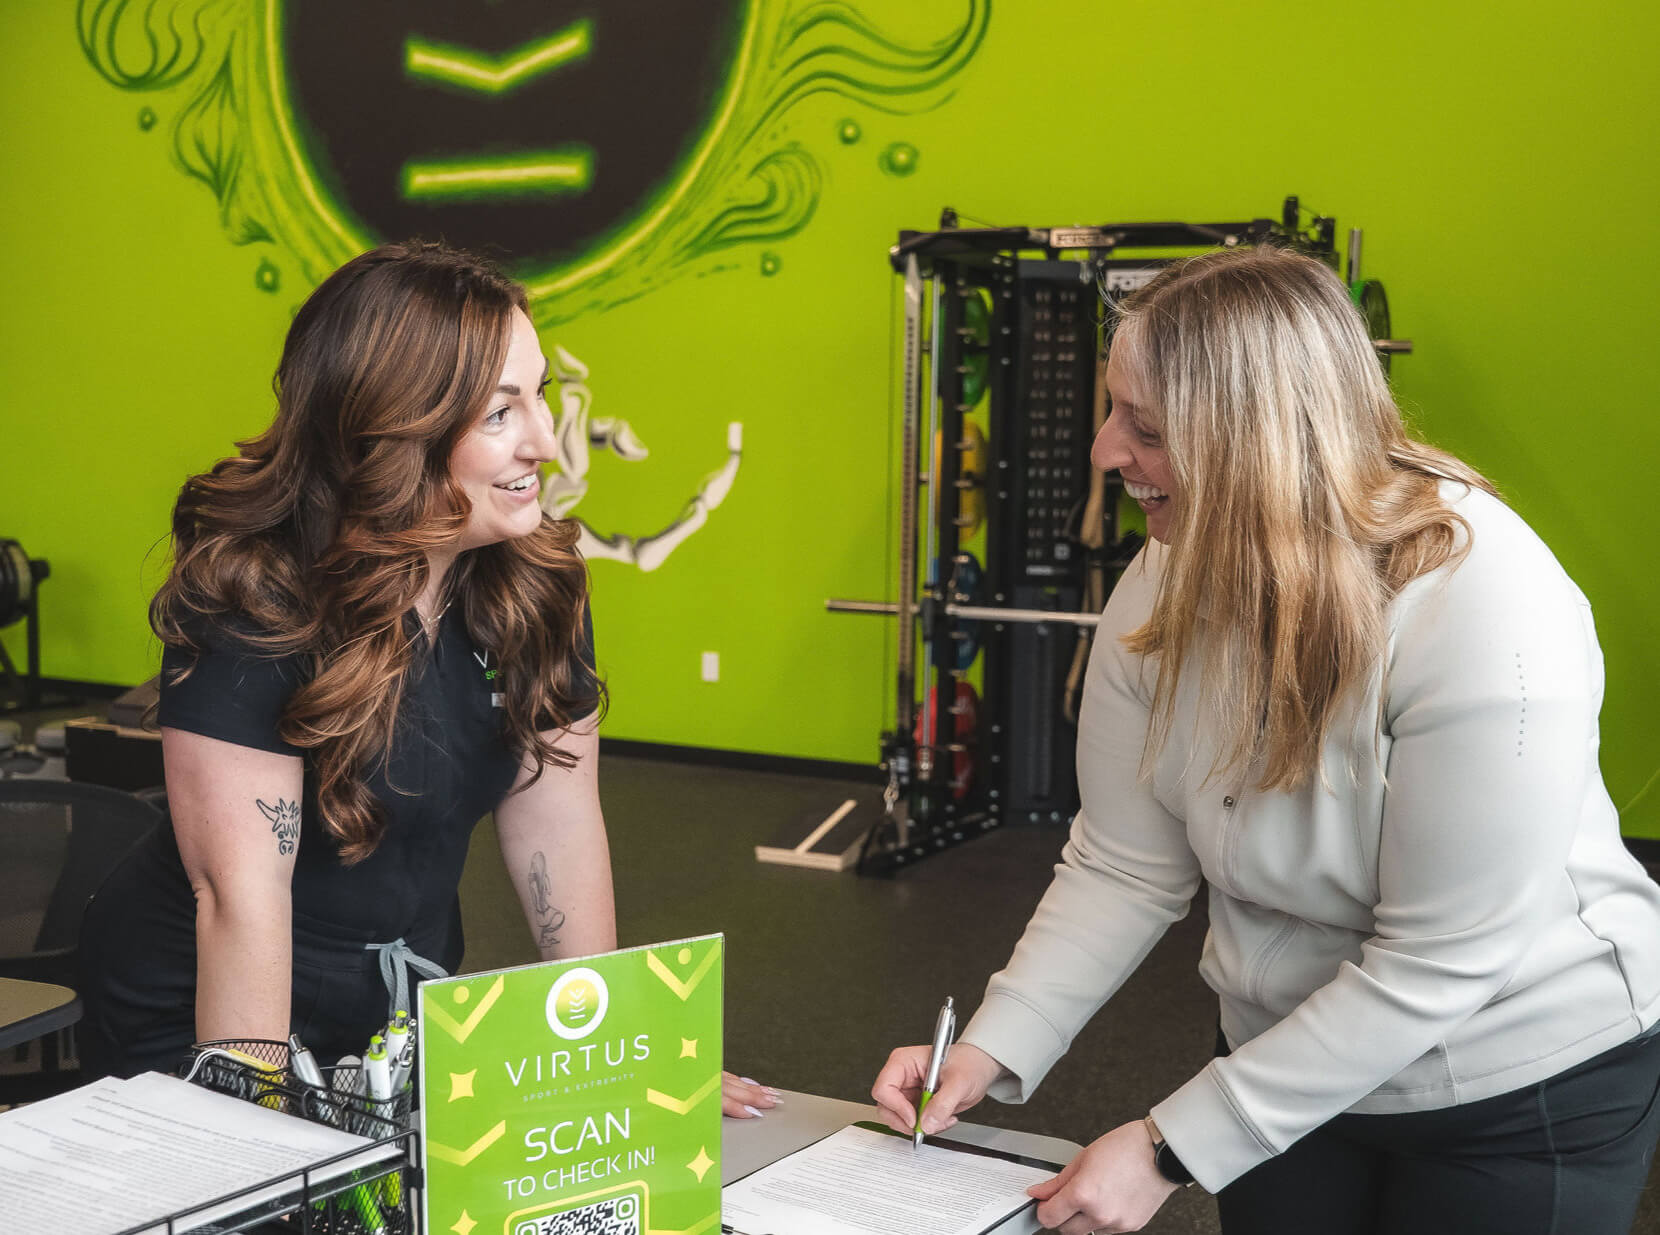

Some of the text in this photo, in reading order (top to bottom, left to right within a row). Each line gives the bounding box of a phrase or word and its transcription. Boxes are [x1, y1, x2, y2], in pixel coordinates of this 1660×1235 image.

[504, 1034, 650, 1087] VIRTUS
[523, 1088, 558, 1102] SPORT
[524, 1107, 630, 1162] SCAN
[503, 1145, 655, 1201] TO CHECK IN!
